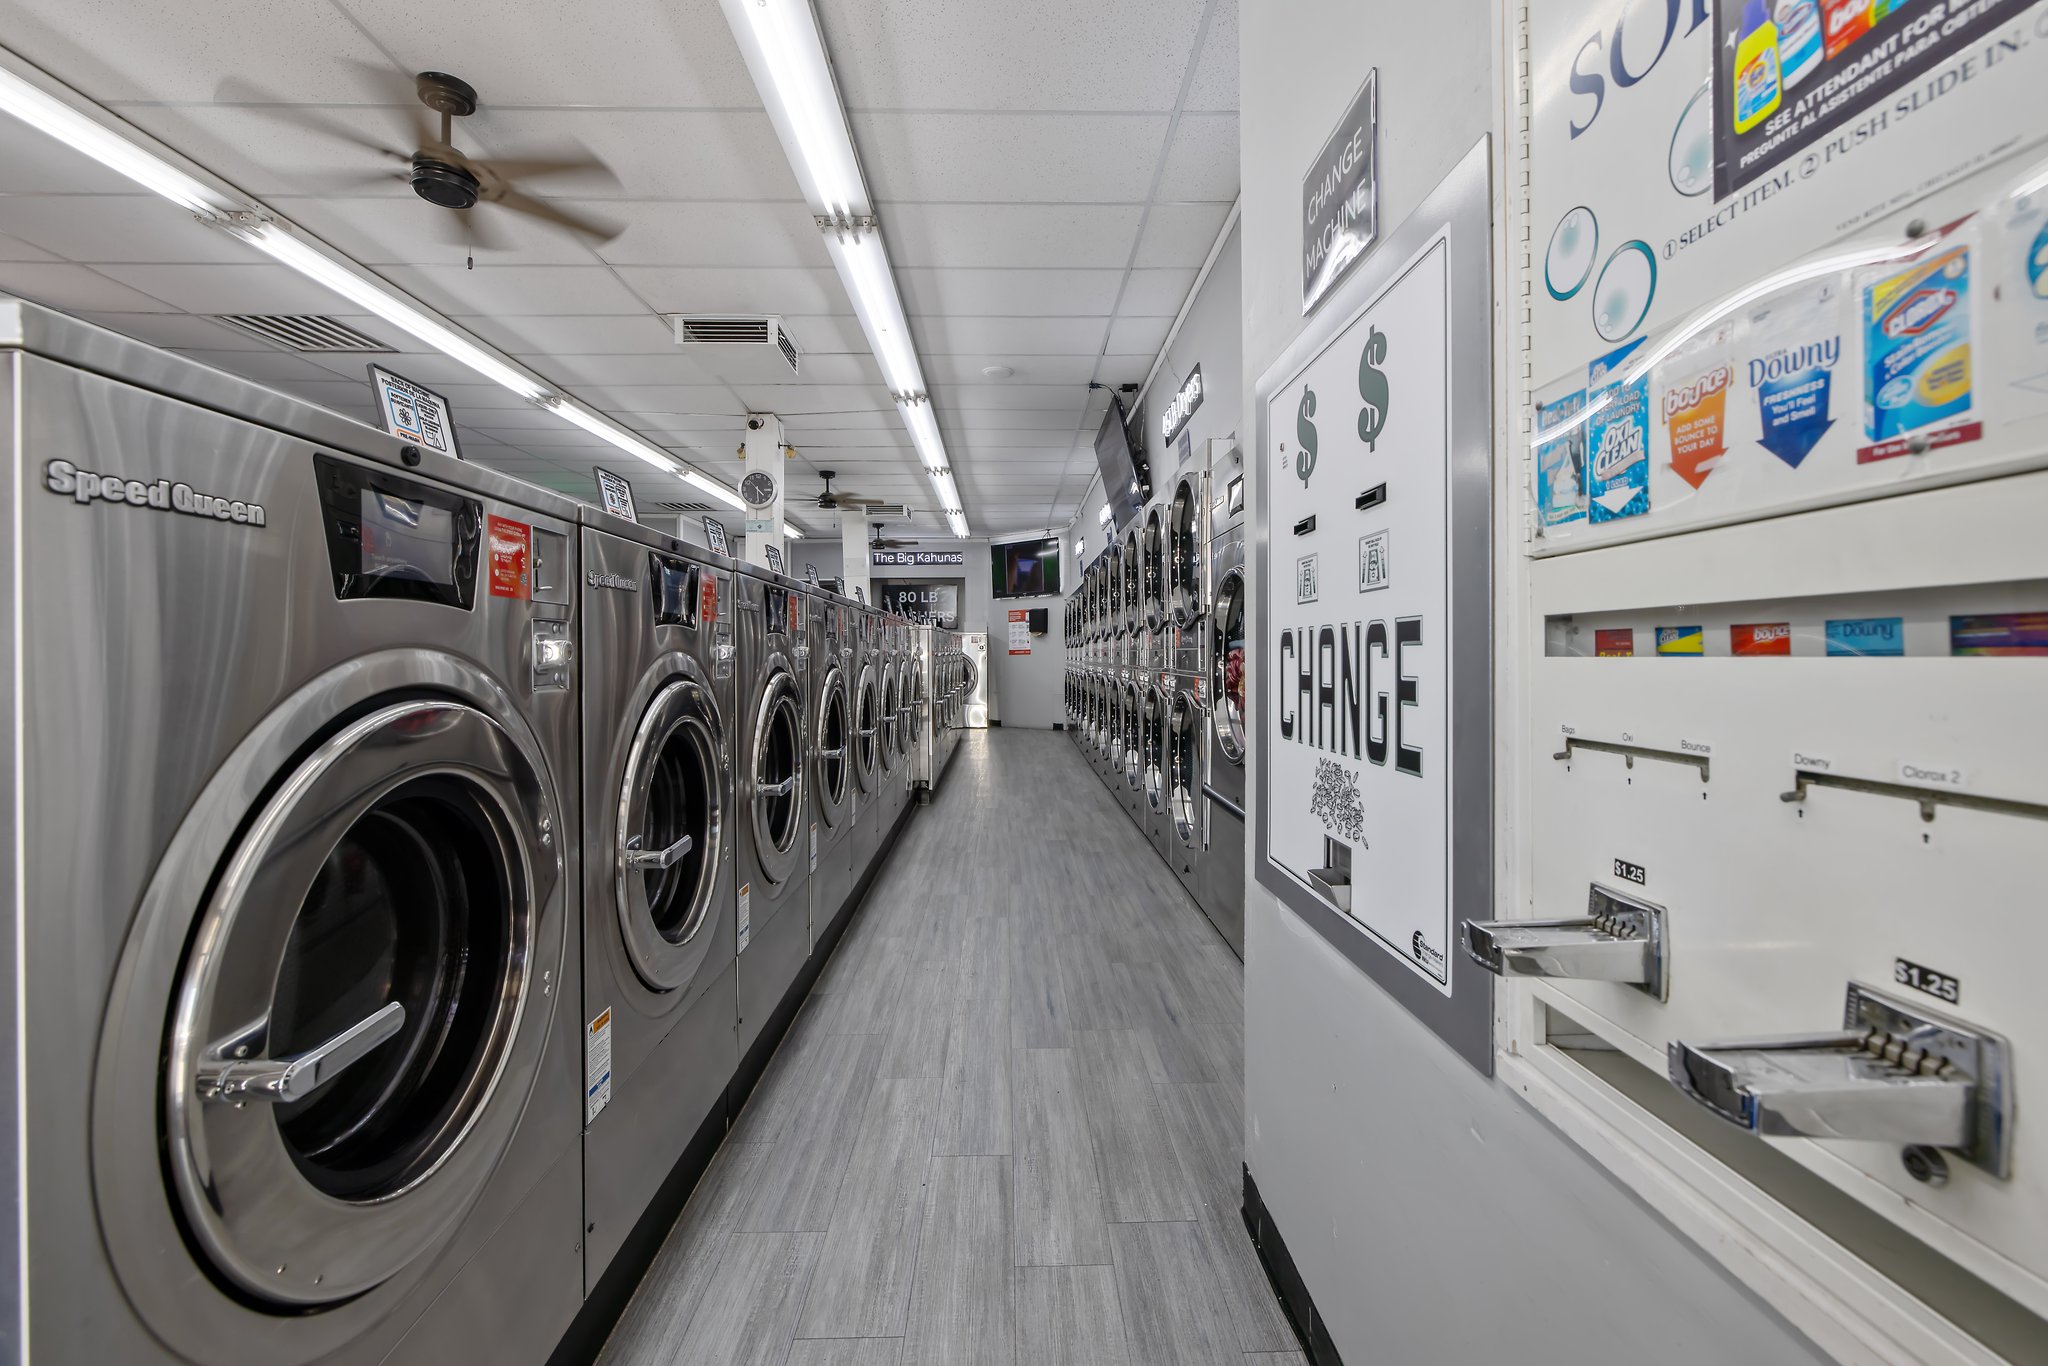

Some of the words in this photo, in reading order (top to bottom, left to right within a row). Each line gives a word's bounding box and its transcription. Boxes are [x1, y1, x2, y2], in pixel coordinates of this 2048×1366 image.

[1765, 108, 1791, 136] SEE
[1794, 33, 1900, 117] ATTENDANT
[1902, 3, 1946, 45] FOR
[1740, 120, 1799, 169] PREGUNTE
[1800, 112, 1818, 130] AL
[1818, 59, 1893, 115] ASISTENTE
[1894, 30, 1940, 68] PARA
[1680, 201, 1738, 250] SELECT
[1743, 171, 1795, 211] ITEM.
[1824, 112, 1888, 163] PUSH
[1895, 57, 1977, 121] SLIDE
[1308, 127, 1362, 224] CHANGE
[1306, 179, 1366, 278] MACHINE
[1748, 335, 1841, 388] Downy
[1666, 367, 1728, 415] bounce
[1763, 378, 1825, 406] FRESHNESS
[1676, 423, 1692, 434] ADD
[1694, 416, 1715, 430] SOME
[1772, 414, 1789, 426] and
[1604, 420, 1630, 450] OXI
[1675, 431, 1704, 446] BOUNCE
[1707, 425, 1718, 436] TO
[1677, 443, 1697, 455] YOUR
[1700, 438, 1715, 449] DAY
[1595, 430, 1640, 477] CLEAN
[873, 553, 894, 563] The
[897, 552, 915, 565] Big
[917, 552, 963, 563] Kahunas
[898, 591, 917, 603] 80
[920, 591, 938, 603] LB
[1281, 615, 1423, 778] CHANGE
[1561, 724, 1575, 735] Bags
[1622, 733, 1633, 742] Oxi
[1681, 740, 1711, 753] Bounce
[1794, 753, 1830, 770] Downy
[1951, 771, 1961, 784] 2
[1615, 860, 1644, 883] $1.25
[1895, 961, 1957, 1001] $1.25
